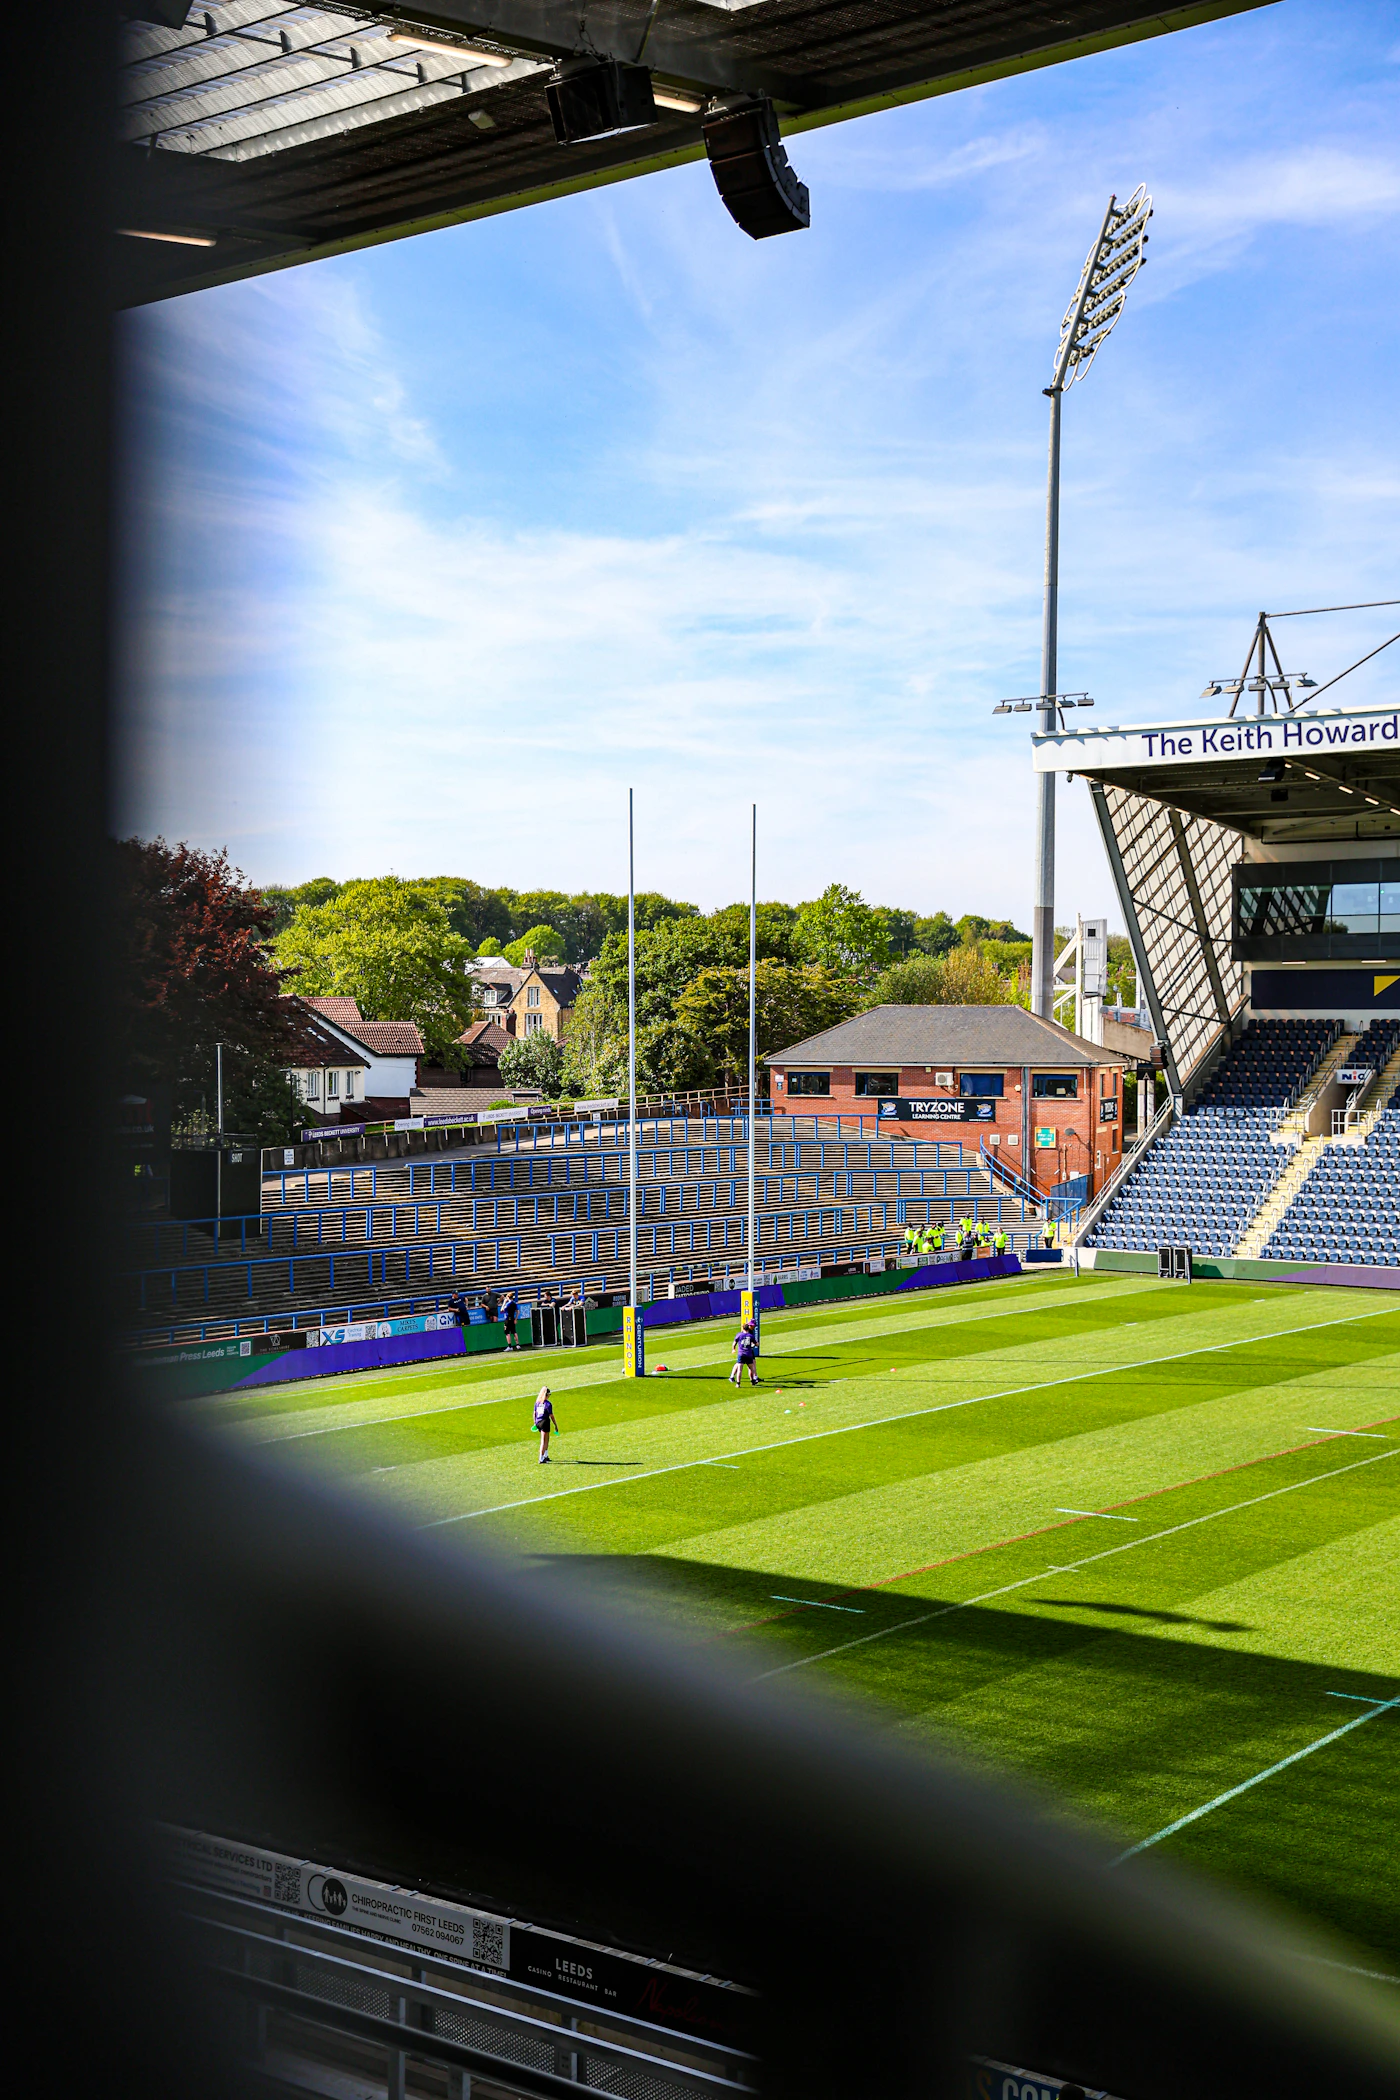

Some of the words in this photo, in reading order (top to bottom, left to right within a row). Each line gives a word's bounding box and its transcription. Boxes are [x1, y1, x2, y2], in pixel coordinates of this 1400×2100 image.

[1142, 733, 1192, 757] The
[1202, 726, 1273, 752] Keith
[1283, 715, 1399, 747] Howard
[909, 1101, 965, 1113] TRYZONE
[312, 1130, 324, 1138] LEEDS
[324, 1128, 339, 1137] BECKETT
[340, 1126, 361, 1135] UNIVERSITY
[427, 1115, 474, 1126] www.leedsbeckett.ac.uk
[397, 1324, 419, 1332] CARPETS
[179, 1351, 201, 1362] Press
[202, 1348, 225, 1359] Leeds
[213, 1846, 255, 1867] SERVICES
[256, 1859, 273, 1872] LTD
[351, 1893, 412, 1919] CHIROPRACTIC
[413, 1911, 436, 1926] FIRST
[438, 1919, 465, 1934] LEEDS
[411, 1923, 435, 1938] 07562
[435, 1929, 464, 1946] 094067
[554, 1957, 593, 1980] LEEDS
[527, 1965, 552, 1978] CASINO
[557, 1974, 598, 1992] RESTAURANT
[604, 1988, 617, 1998] BAR
